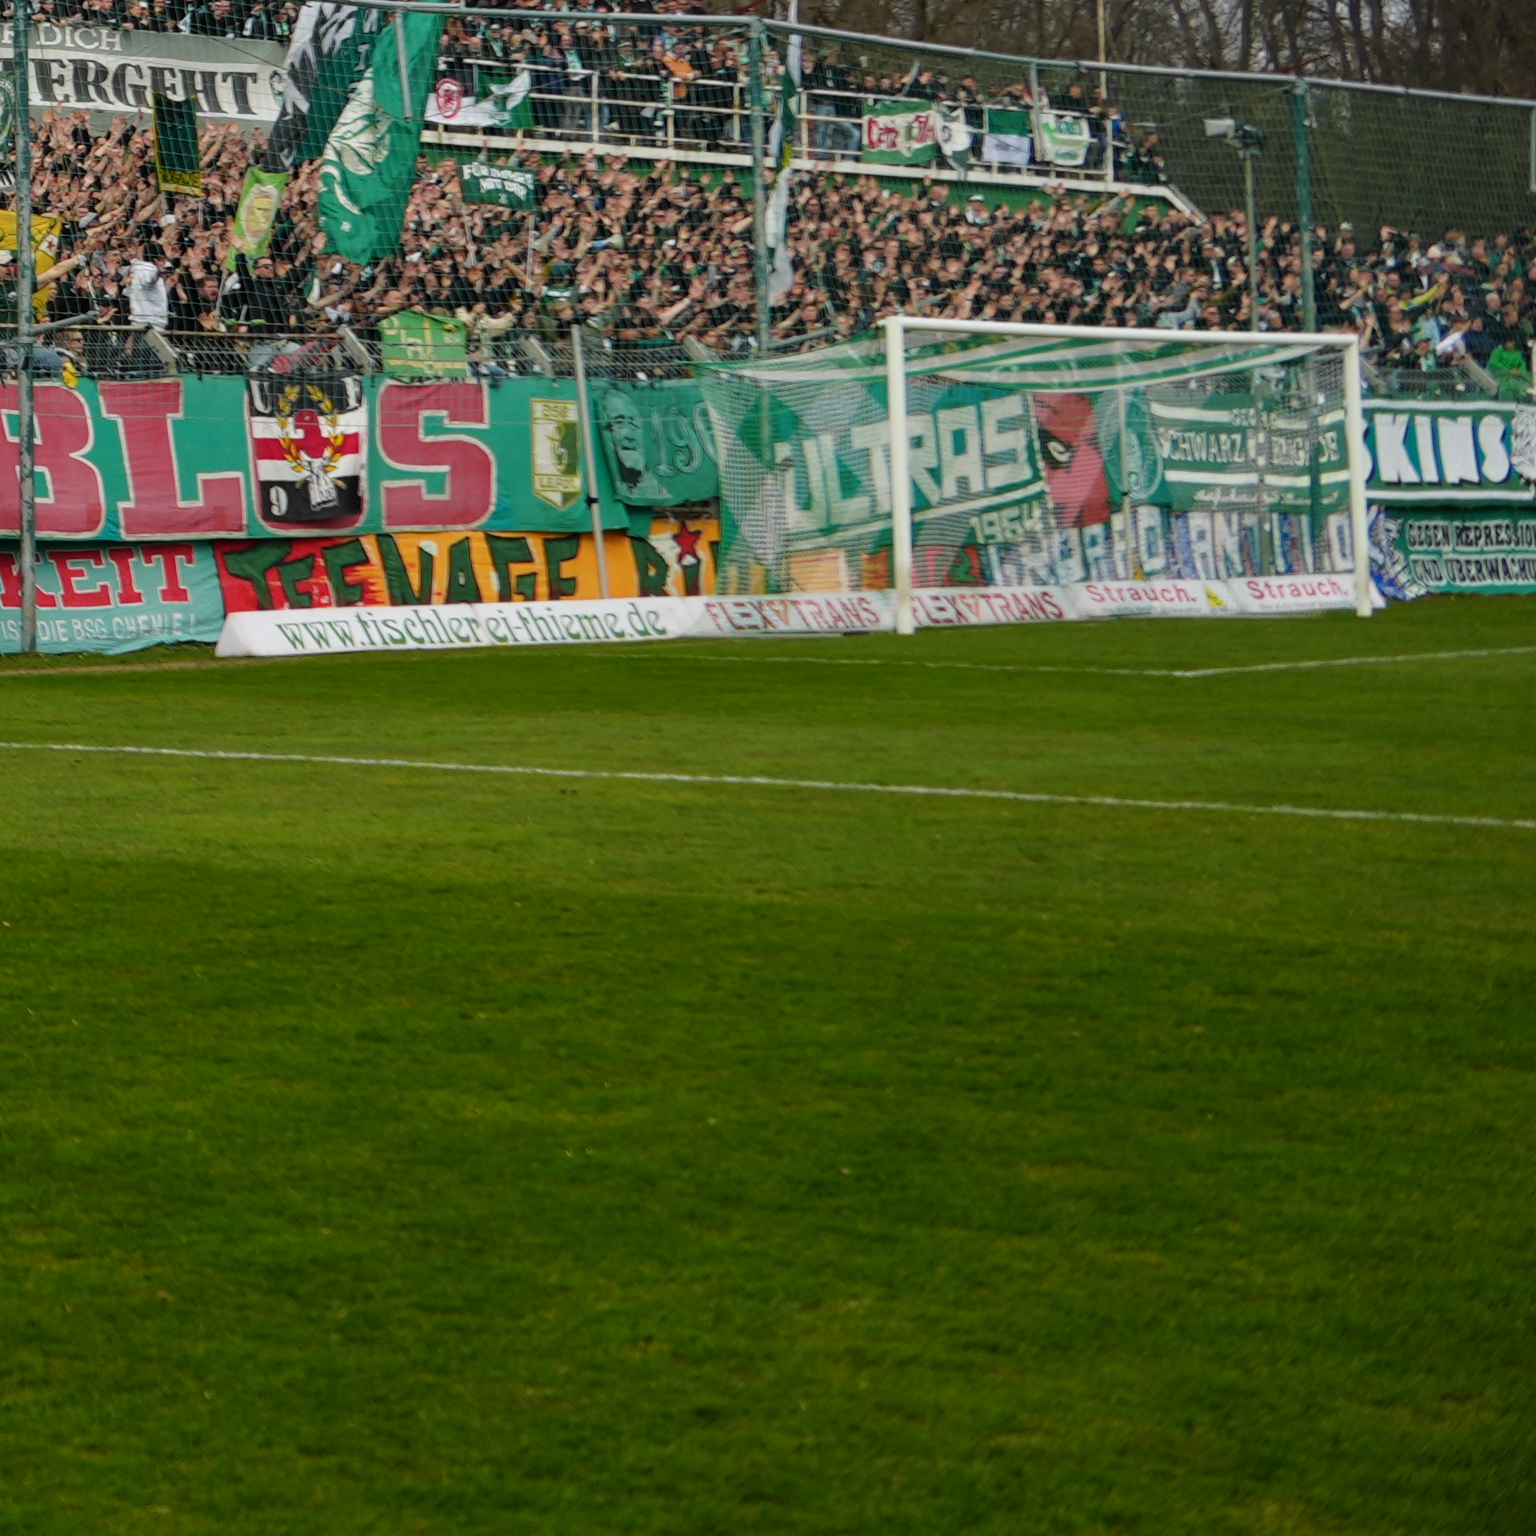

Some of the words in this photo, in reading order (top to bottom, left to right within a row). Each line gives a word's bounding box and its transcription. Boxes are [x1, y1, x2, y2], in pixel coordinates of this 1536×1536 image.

[35, 21, 123, 52] DICH
[774, 394, 1033, 531] ULTRAS
[222, 531, 580, 611] TEENAGE
[1, 619, 25, 641] IS
[37, 619, 68, 642] DIE
[71, 616, 107, 639] BSG
[274, 600, 668, 651] www.tischlerei-thieme.de
